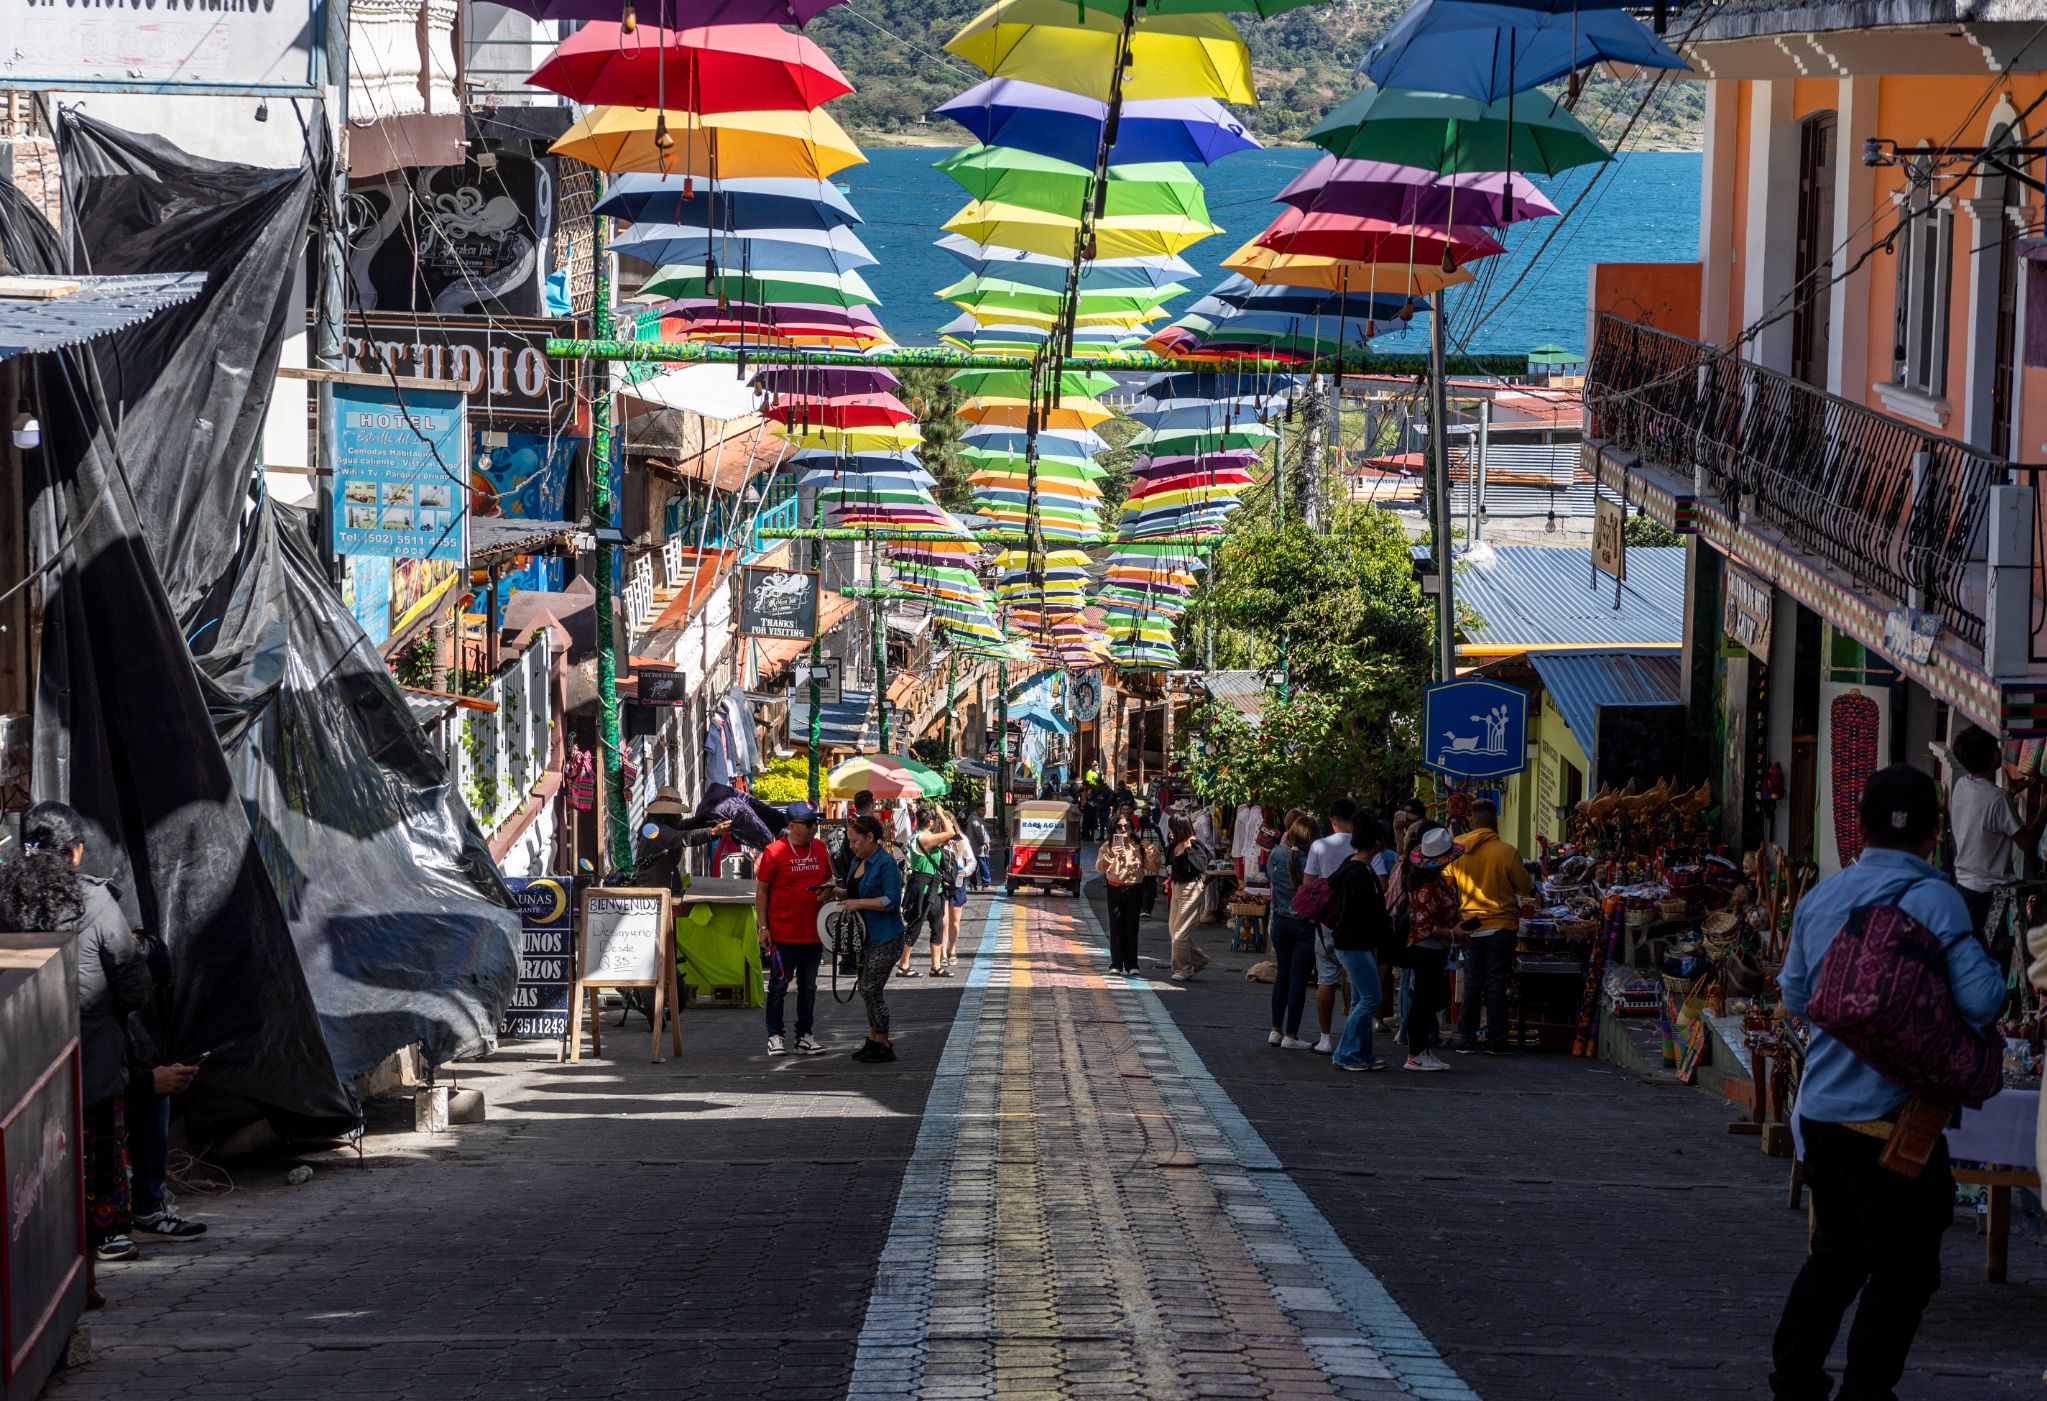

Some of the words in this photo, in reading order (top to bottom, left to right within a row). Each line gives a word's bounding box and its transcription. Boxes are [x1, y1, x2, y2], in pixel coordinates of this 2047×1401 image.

[360, 413, 436, 430] HOTEL
[360, 458, 395, 466] caliente
[341, 468, 358, 476] Wifi
[340, 532, 361, 542] Tel.
[364, 534, 394, 545] (502)
[397, 535, 424, 545] 5511
[760, 617, 795, 628] THANKS
[751, 625, 767, 635] FOR
[769, 627, 805, 637] VISITING
[1042, 821, 1065, 829] AGUA
[791, 864, 820, 872] HILFIGER
[599, 940, 634, 953] Desde
